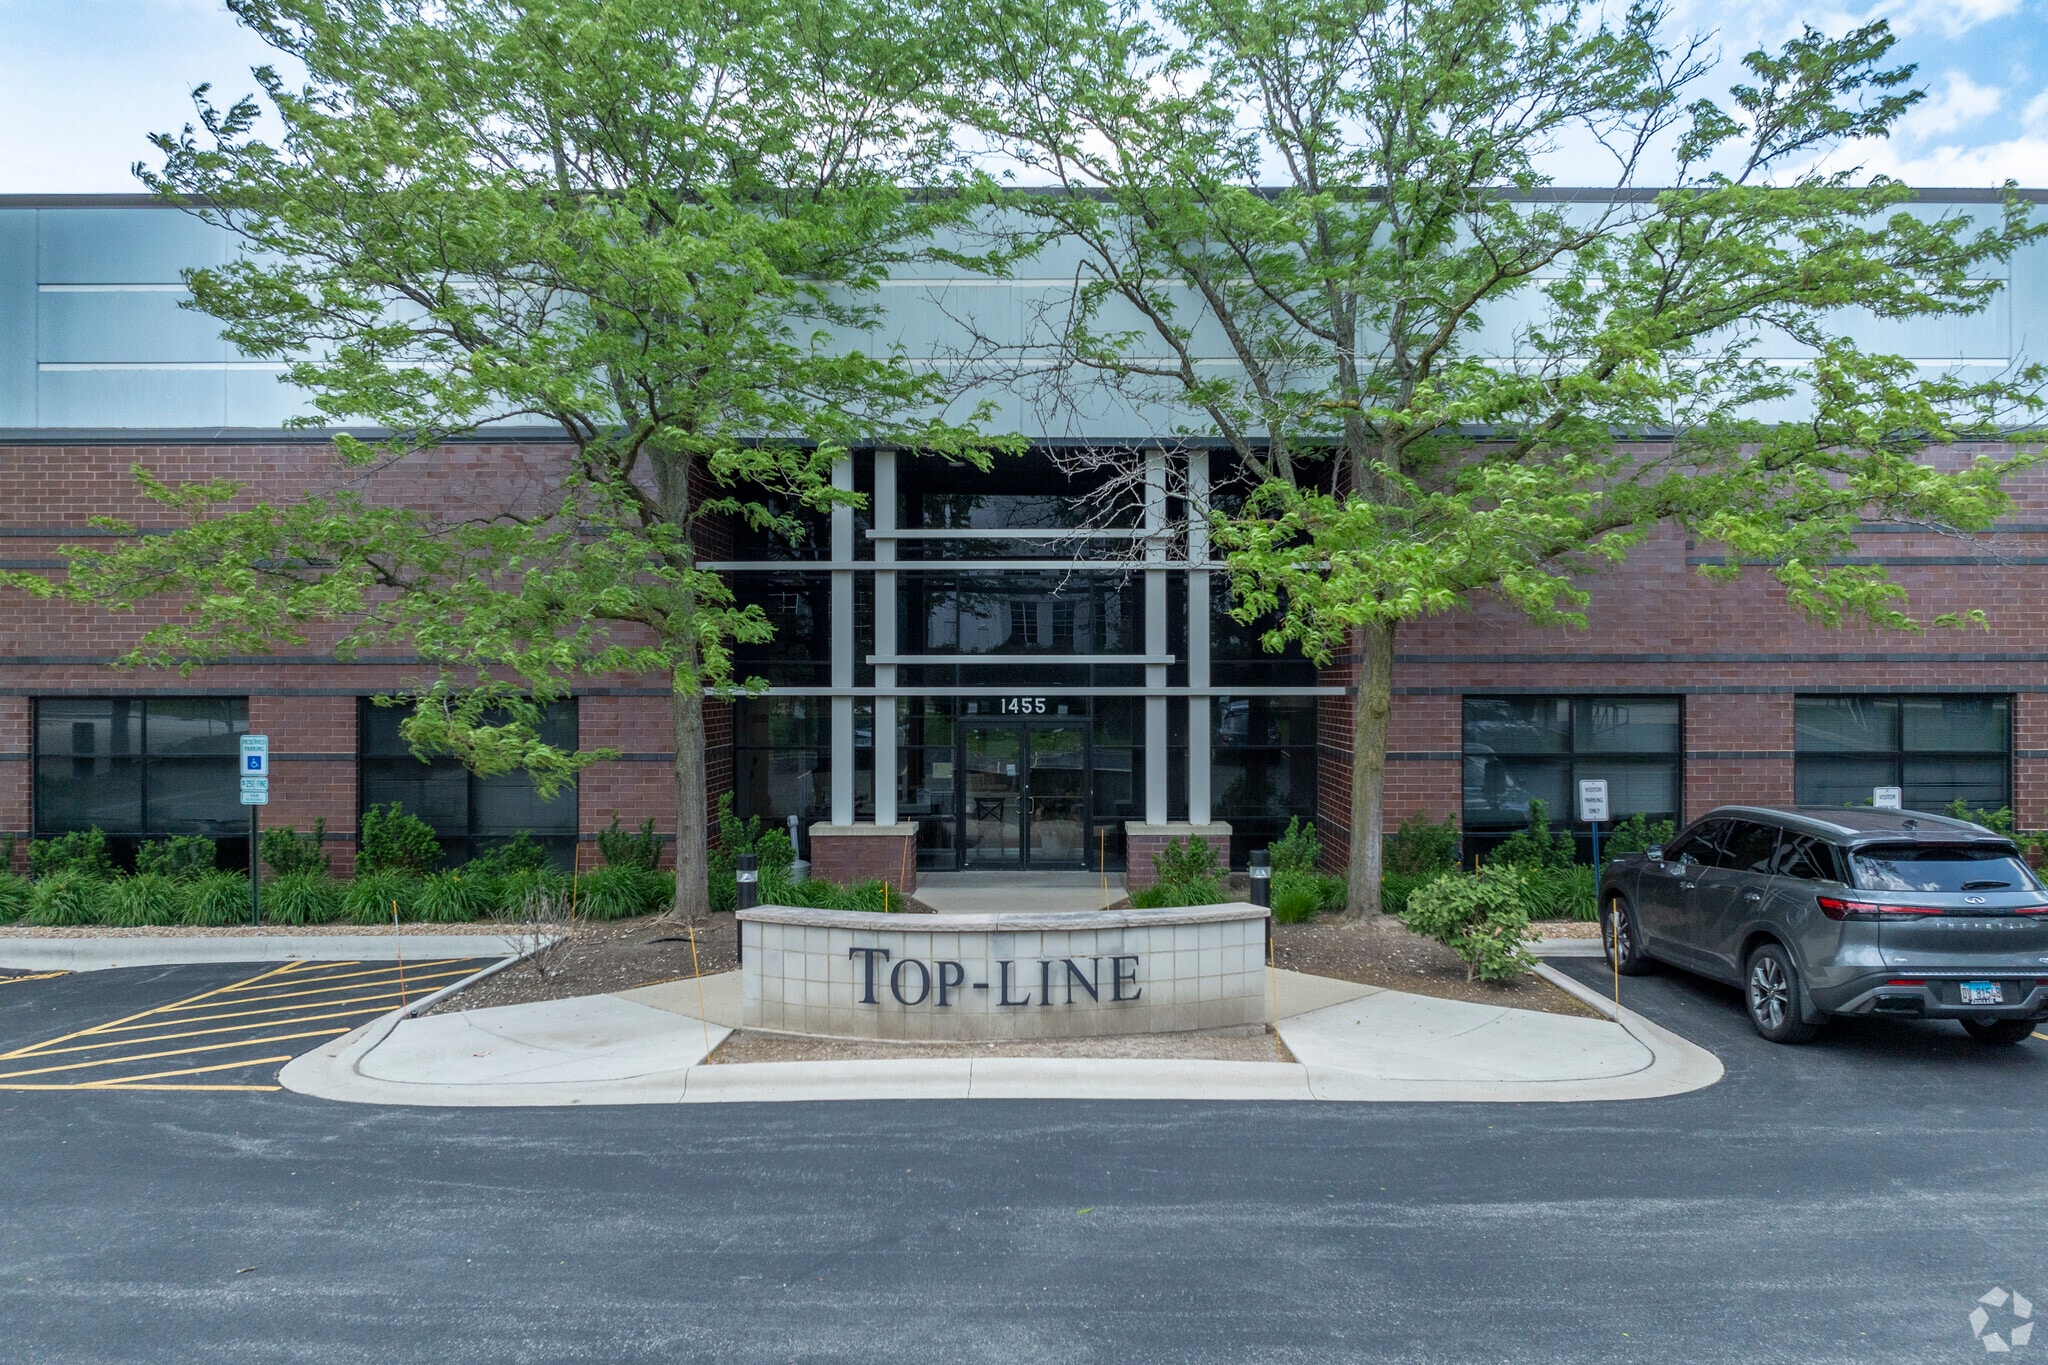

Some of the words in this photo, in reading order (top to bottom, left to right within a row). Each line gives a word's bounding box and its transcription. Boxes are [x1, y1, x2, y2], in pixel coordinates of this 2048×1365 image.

[1001, 697, 1046, 714] 1455
[256, 780, 267, 788] FINE
[848, 947, 1143, 1007] TOP-LINE
